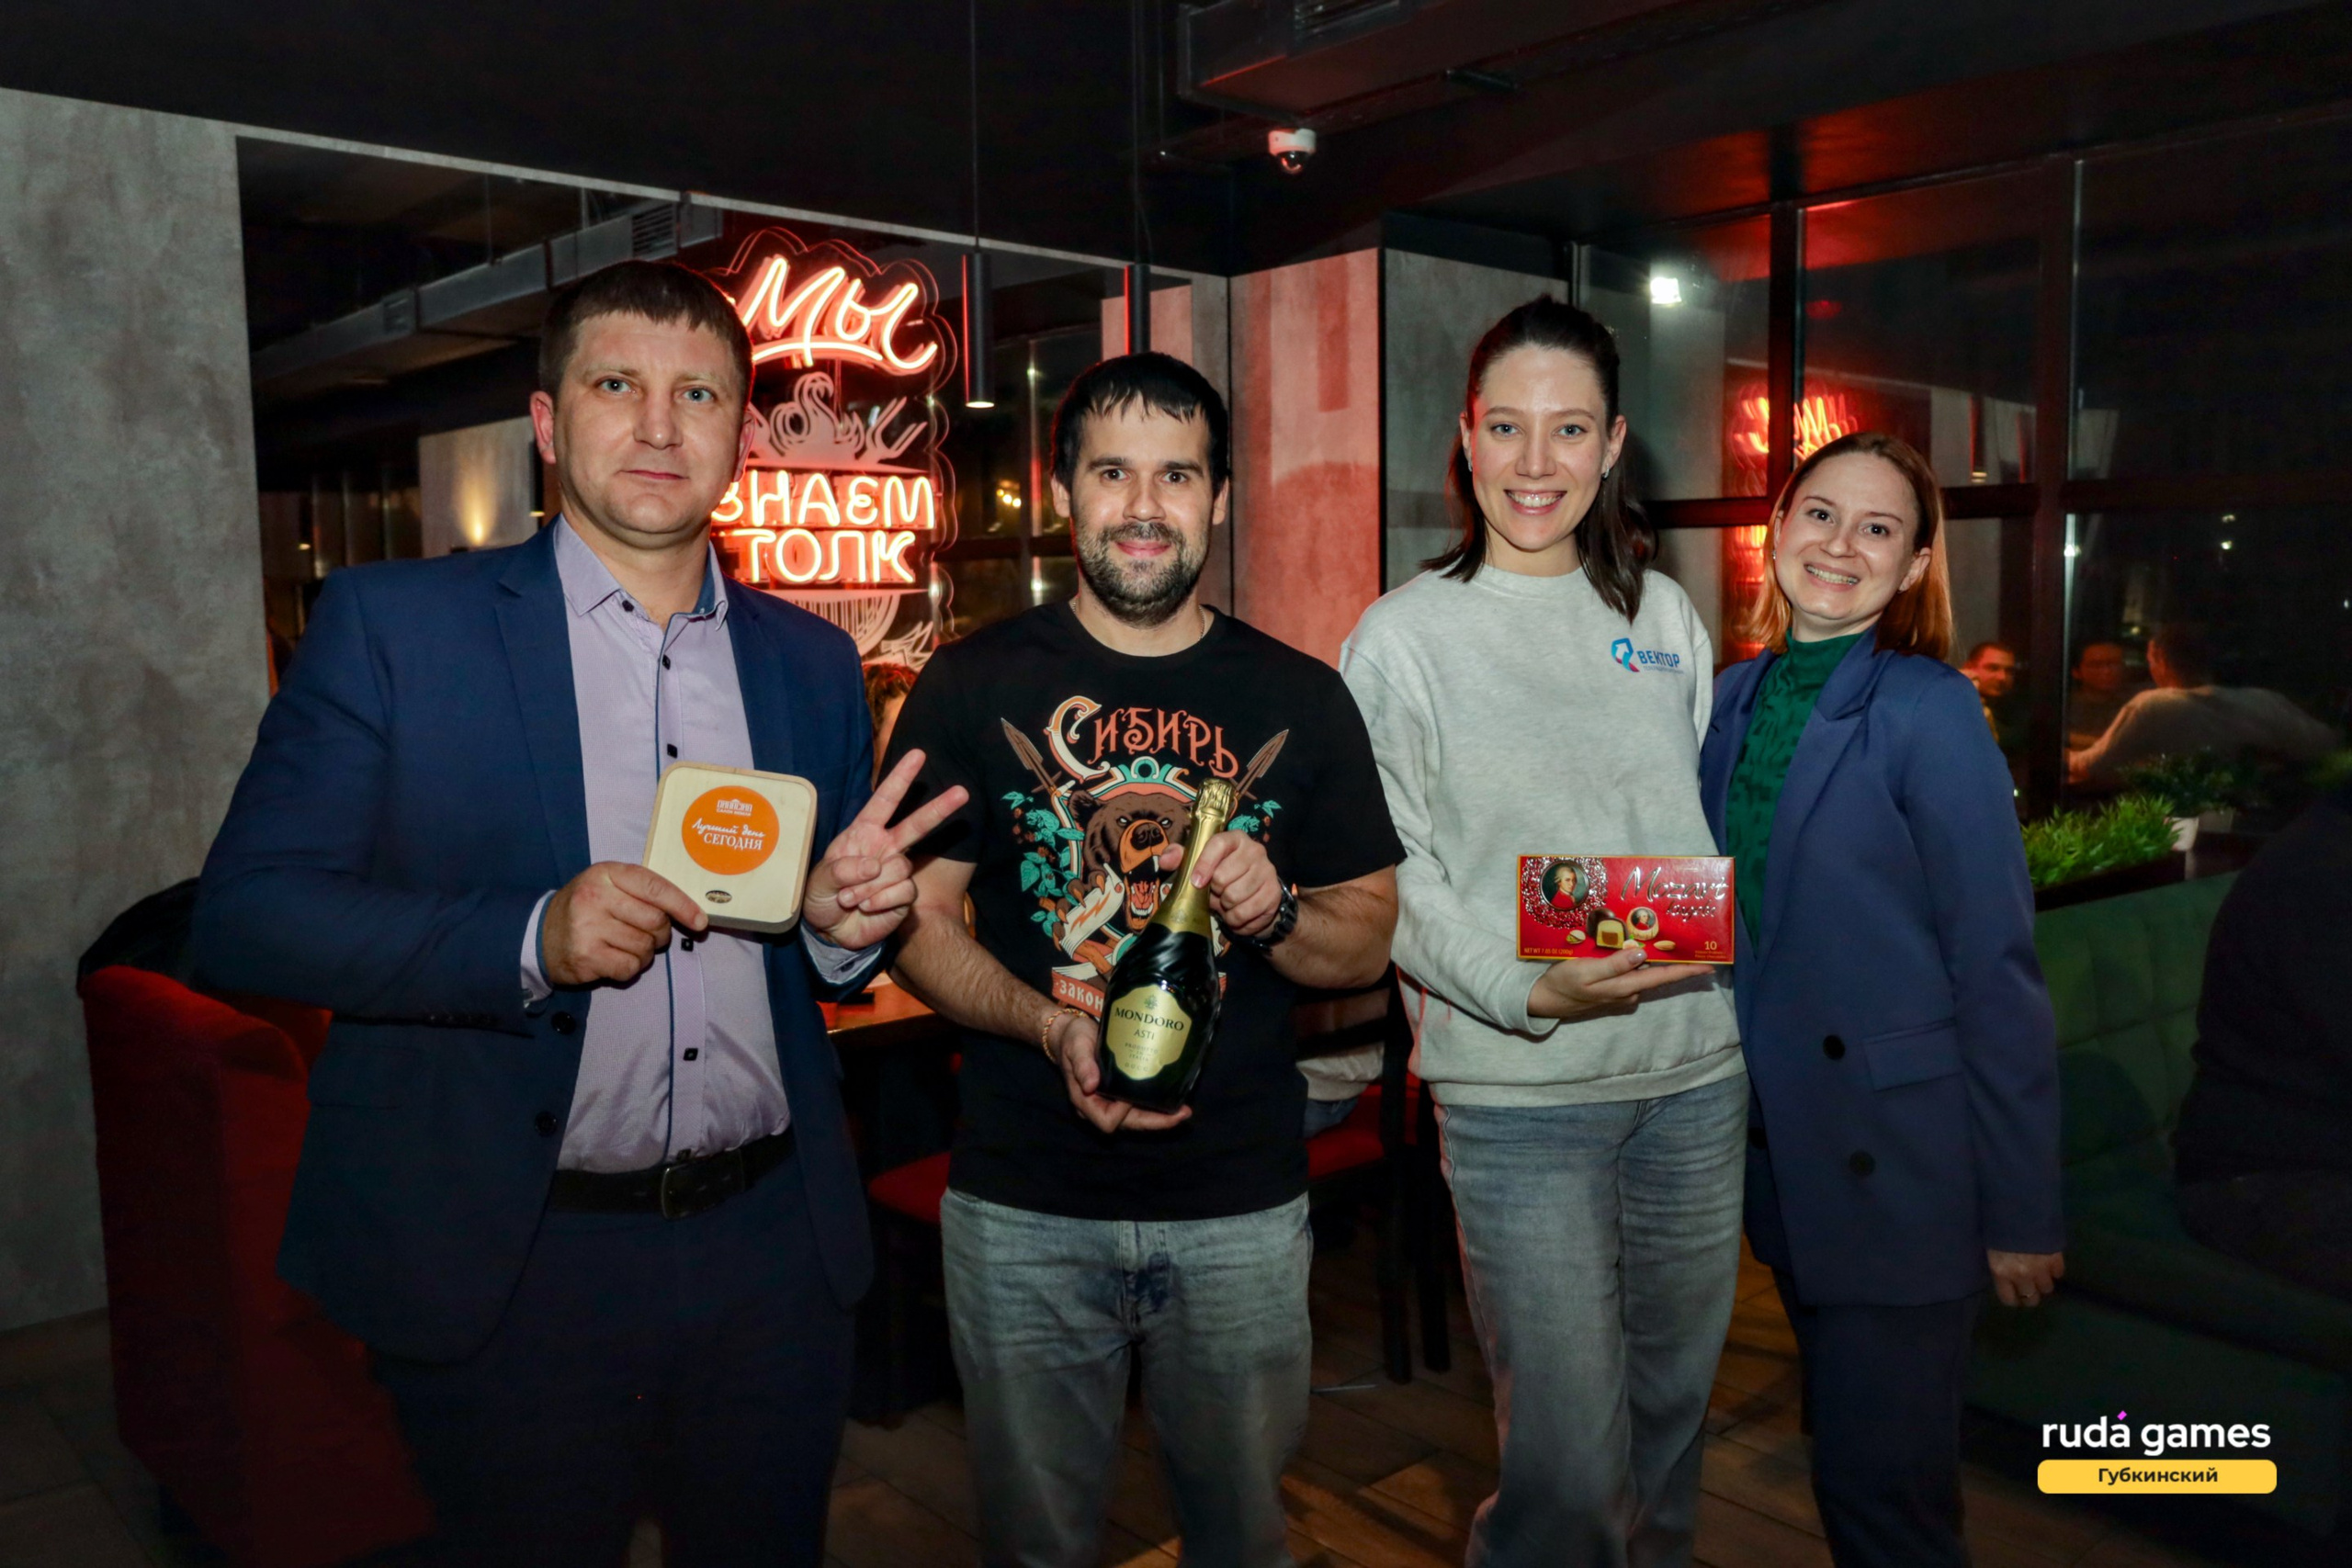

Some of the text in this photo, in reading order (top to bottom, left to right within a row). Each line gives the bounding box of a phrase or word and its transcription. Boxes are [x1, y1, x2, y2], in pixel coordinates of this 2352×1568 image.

[731, 529, 917, 583] ТОЛК
[1636, 649, 1680, 668] ВЕКТОР
[692, 818, 739, 835] Лучший
[704, 832, 763, 851] СЕГОДНЯ
[1621, 866, 1728, 902] Mozart
[1704, 941, 1718, 951] 10
[1114, 1007, 1184, 1032] MONDORO
[1134, 1029, 1155, 1040] ASTI
